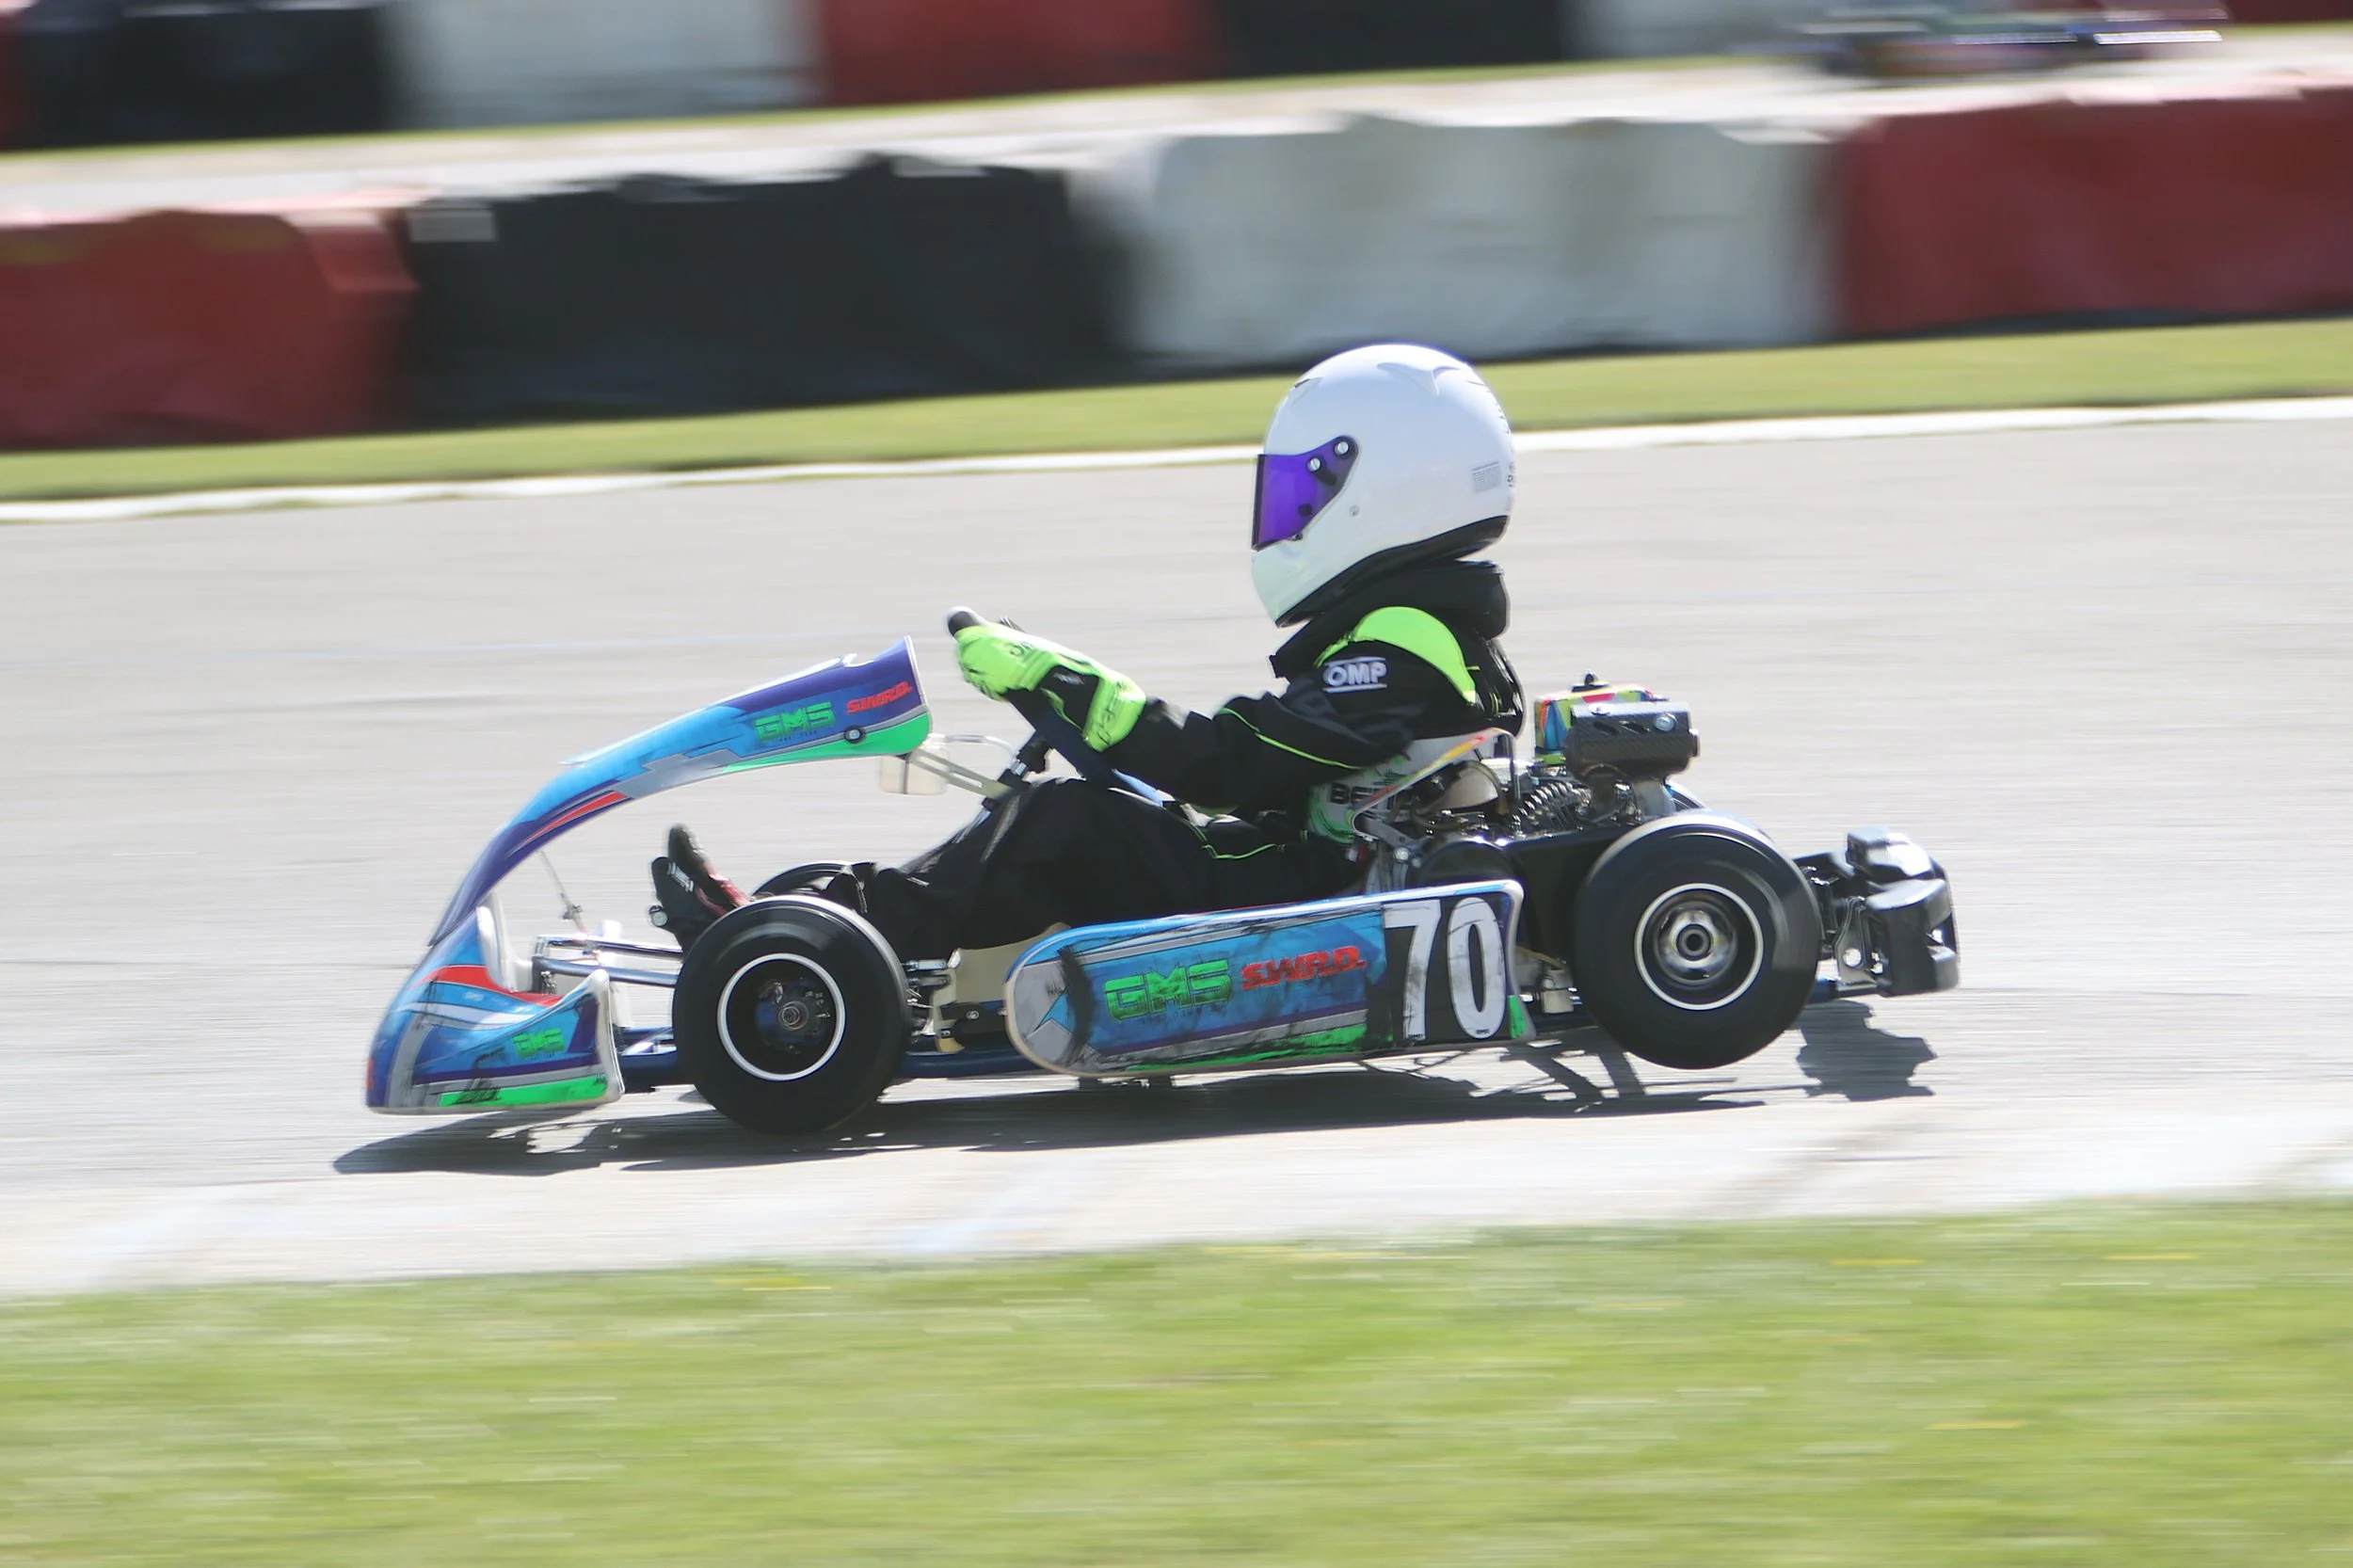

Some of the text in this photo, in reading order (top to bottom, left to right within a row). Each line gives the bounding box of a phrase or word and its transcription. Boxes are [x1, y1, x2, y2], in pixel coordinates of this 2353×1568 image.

[1322, 660, 1387, 687] OMP
[755, 701, 836, 742] GMS
[1104, 959, 1233, 1022] GMS
[1383, 897, 1506, 1041] 70
